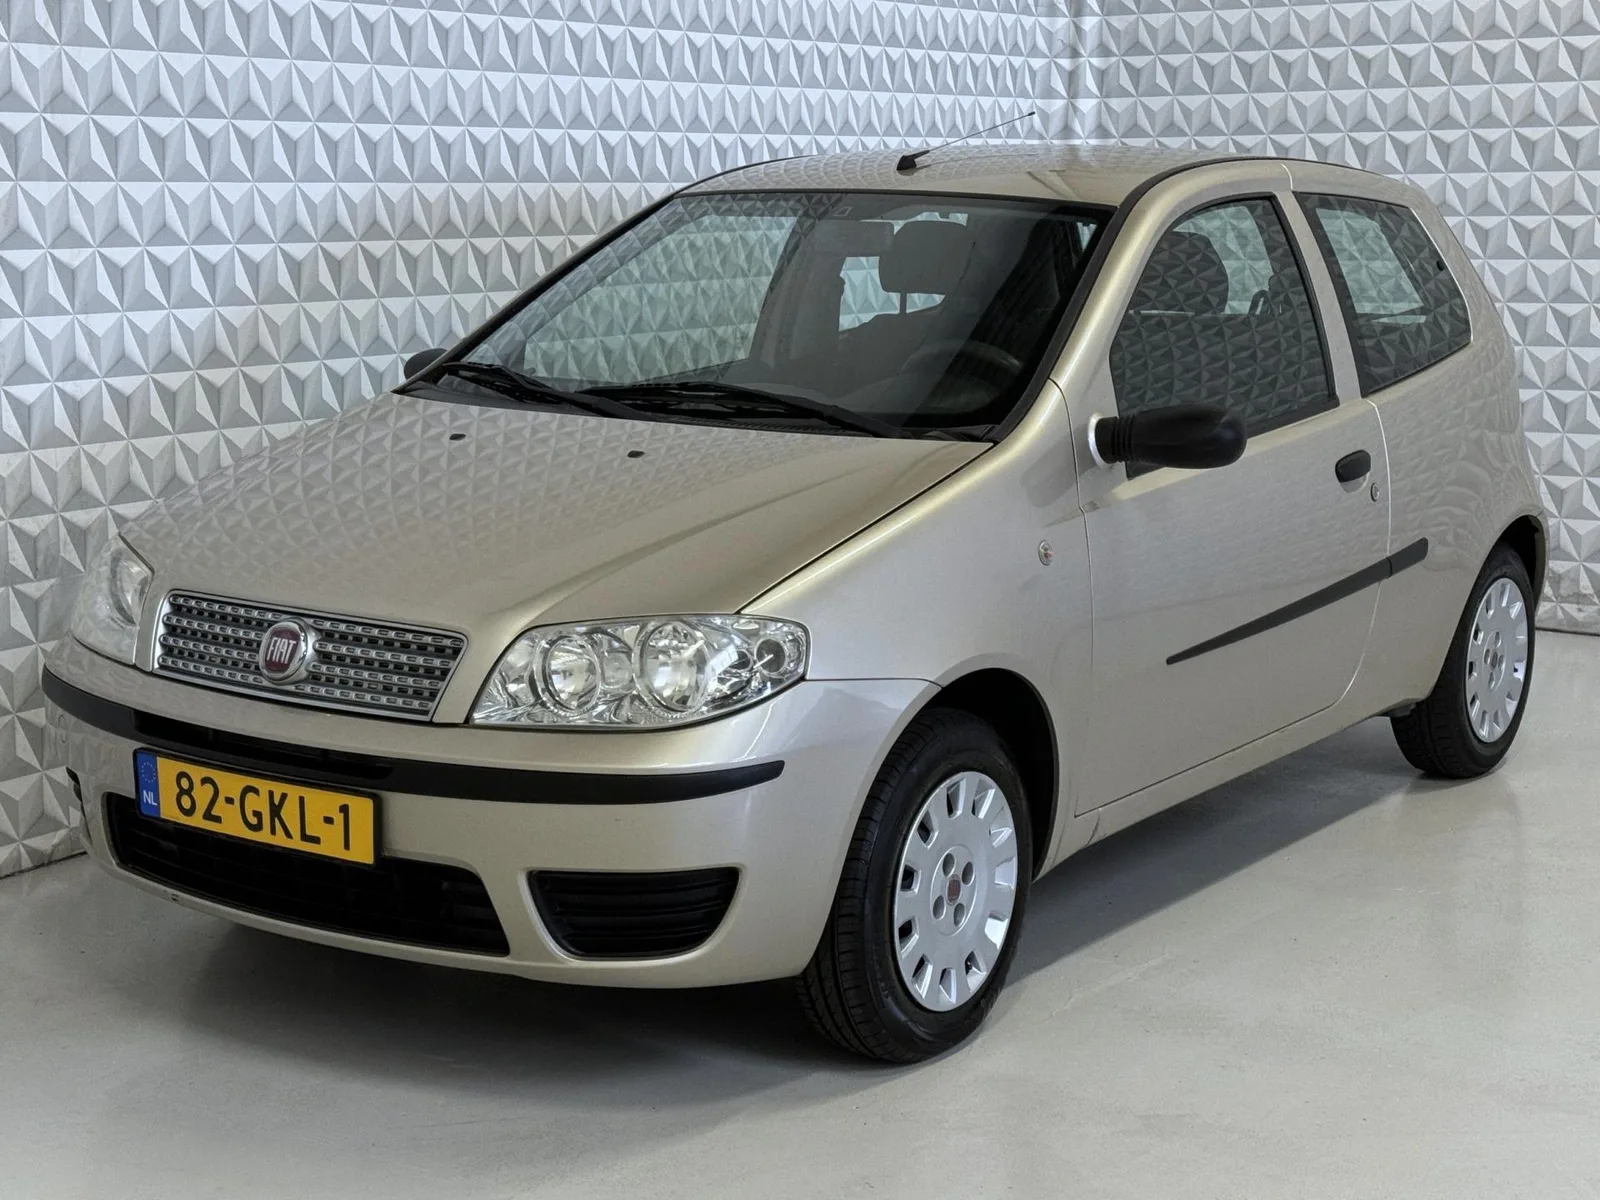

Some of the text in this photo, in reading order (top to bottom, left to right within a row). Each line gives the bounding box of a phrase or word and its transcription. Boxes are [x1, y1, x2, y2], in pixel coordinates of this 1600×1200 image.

[266, 636, 297, 664] FIAT
[143, 789, 158, 806] NL
[175, 771, 351, 851] 82-GKL-1
